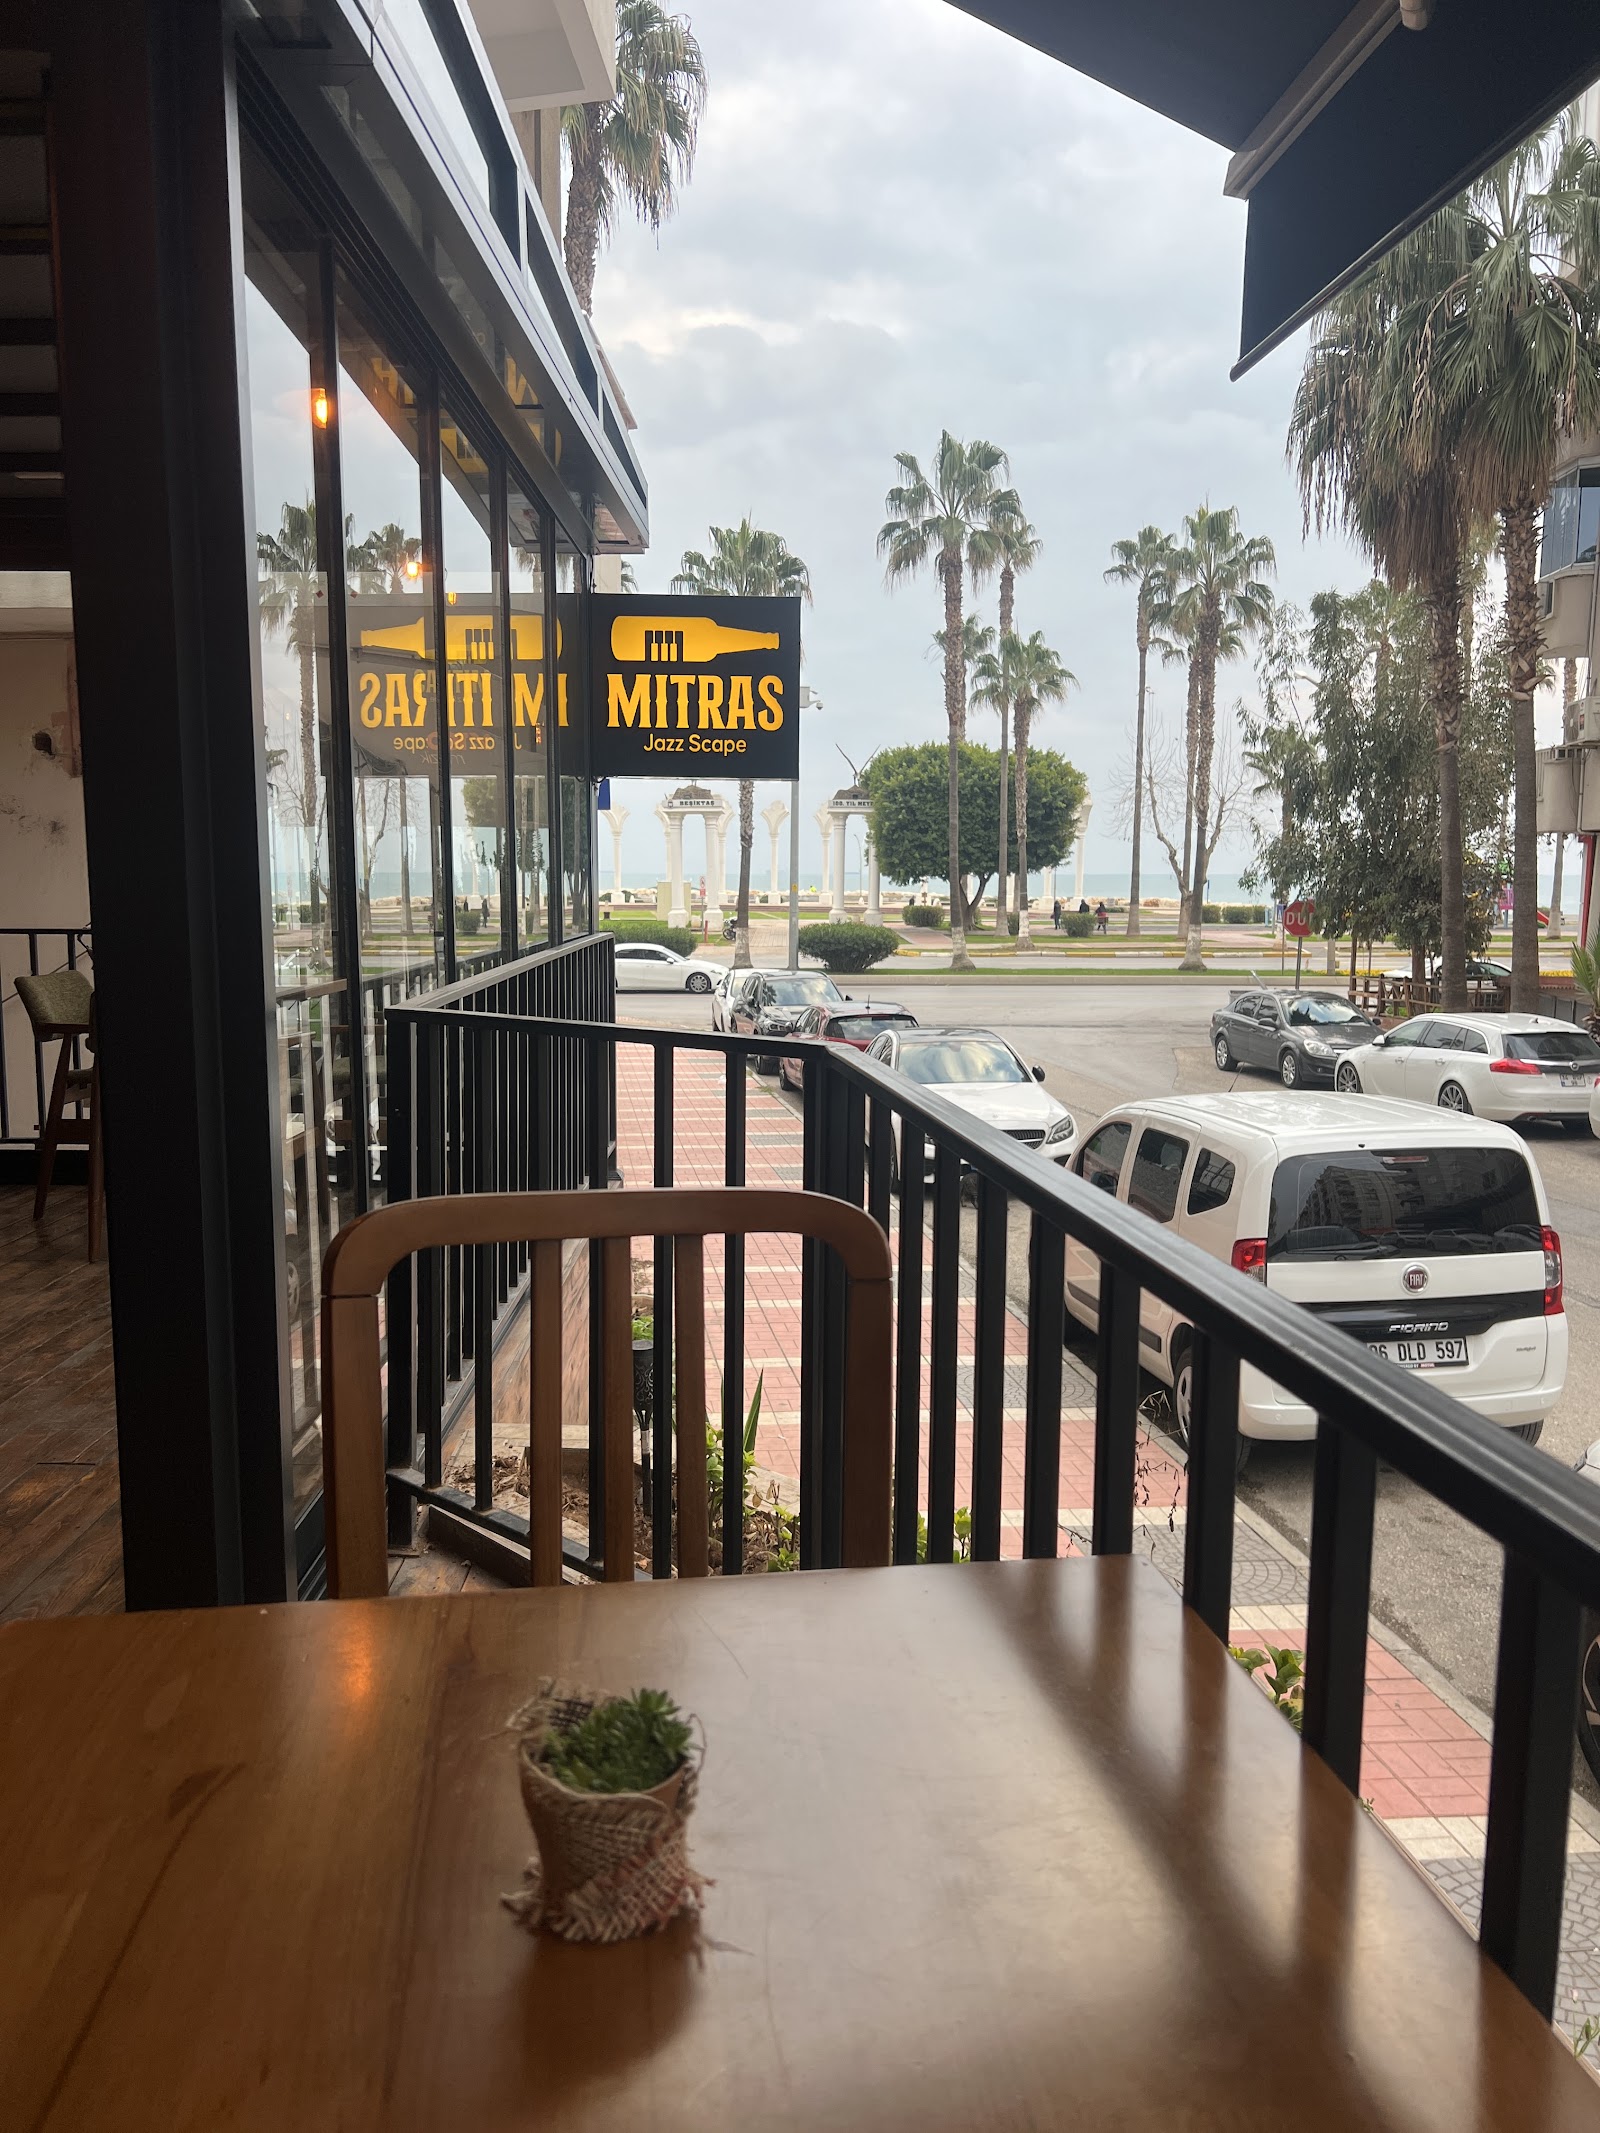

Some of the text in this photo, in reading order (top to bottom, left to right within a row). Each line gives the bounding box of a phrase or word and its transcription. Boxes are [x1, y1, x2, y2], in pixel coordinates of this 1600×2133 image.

[606, 673, 784, 731] MITRAS
[643, 733, 747, 756] Jazz Scape
[1286, 911, 1314, 926] DU
[1409, 1273, 1424, 1286] FIAT
[1388, 1321, 1449, 1333] FIORINO
[1397, 1342, 1427, 1361] DLD
[1435, 1340, 1463, 1359] 597
